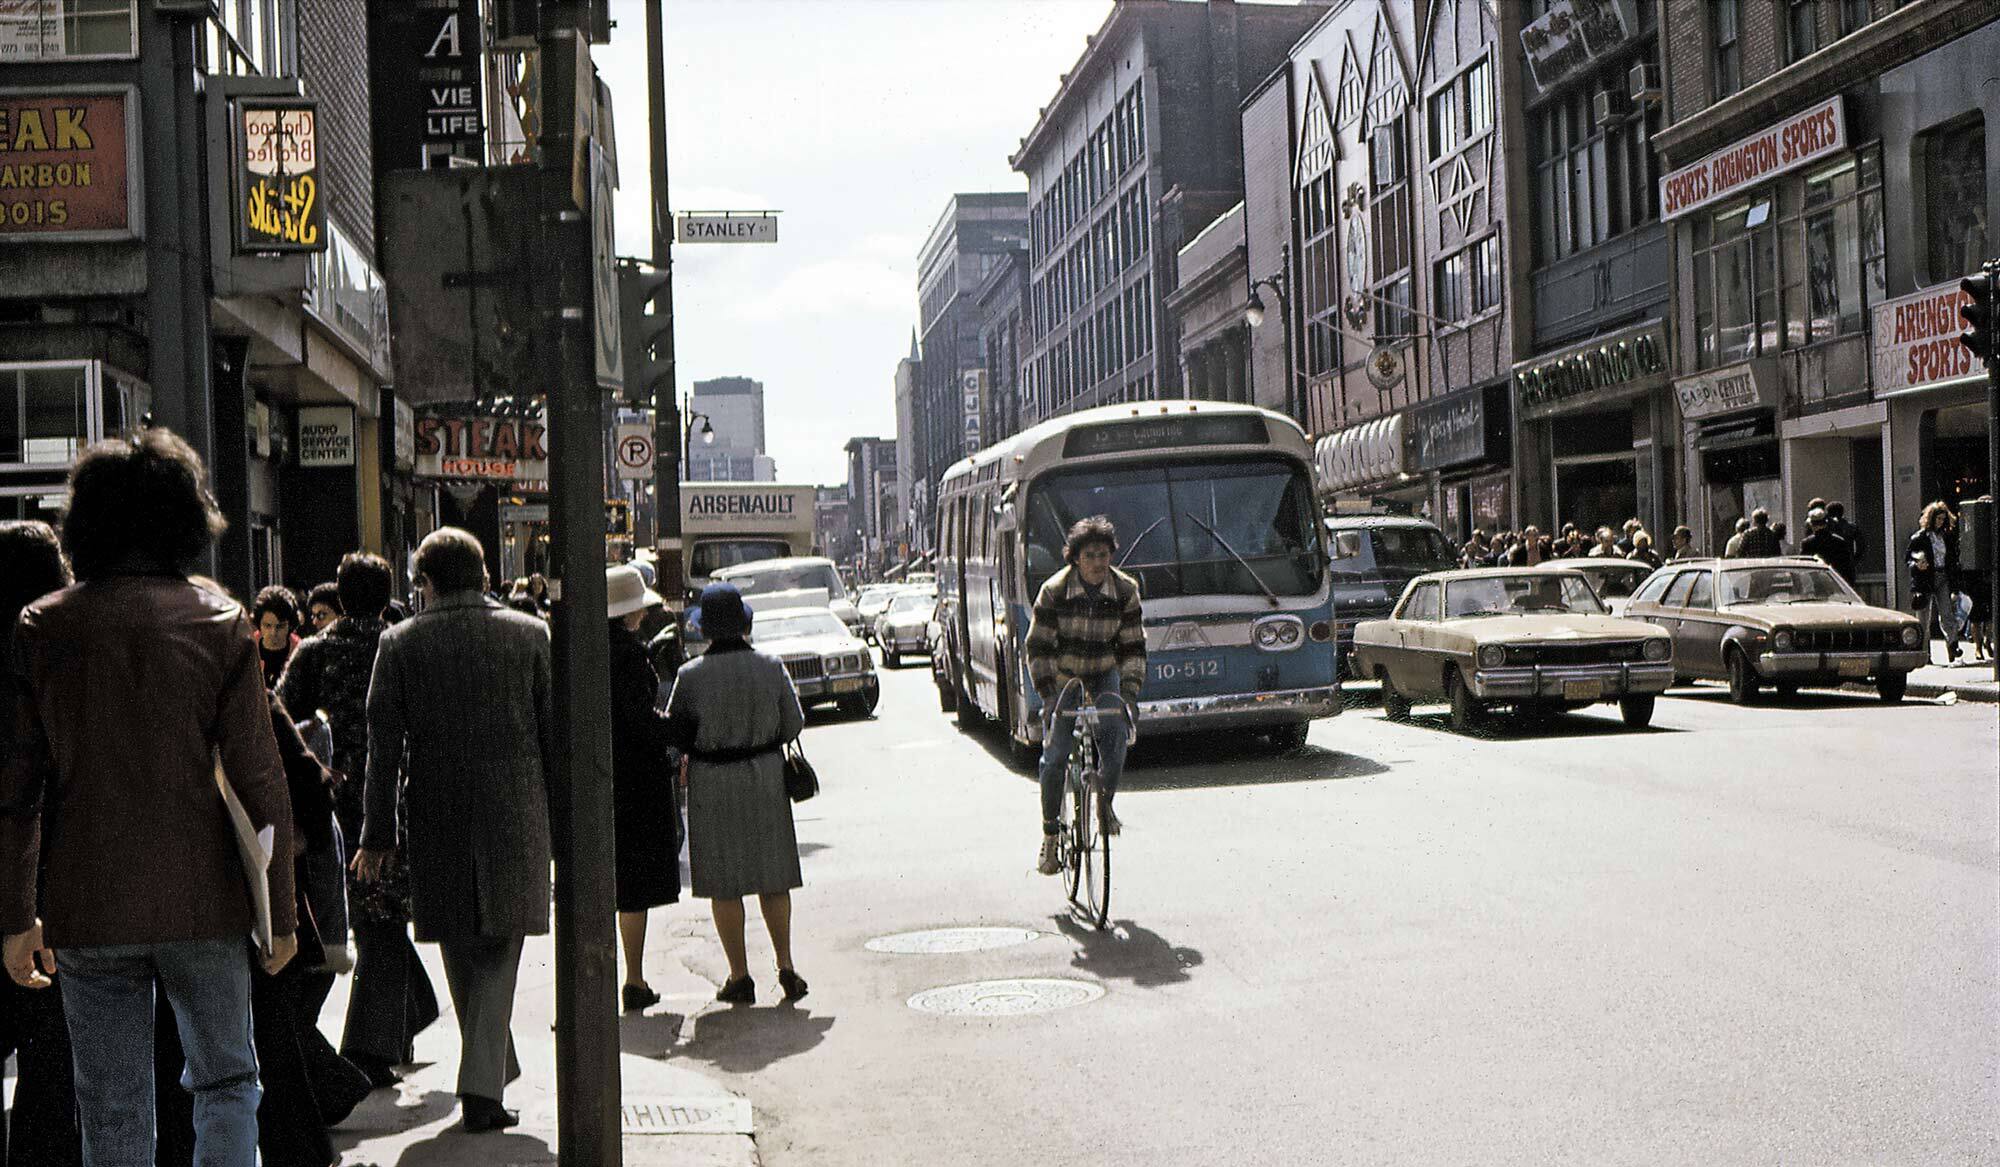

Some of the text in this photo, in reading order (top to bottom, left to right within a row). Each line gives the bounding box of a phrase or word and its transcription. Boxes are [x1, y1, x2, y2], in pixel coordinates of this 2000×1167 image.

[431, 87, 472, 106] VIE
[427, 116, 478, 134] LIFE
[1665, 164, 1709, 213] SPORTS
[1782, 105, 1836, 164] SPORTS
[686, 222, 756, 237] STANLEY
[1907, 336, 1971, 385] SPORTS
[302, 424, 338, 435] AUDIO
[302, 436, 350, 448] SERVICE
[416, 418, 548, 460] STEAK
[302, 449, 347, 460] CENTER
[441, 459, 516, 477] HOUSE
[689, 494, 795, 514] ARSENAULT
